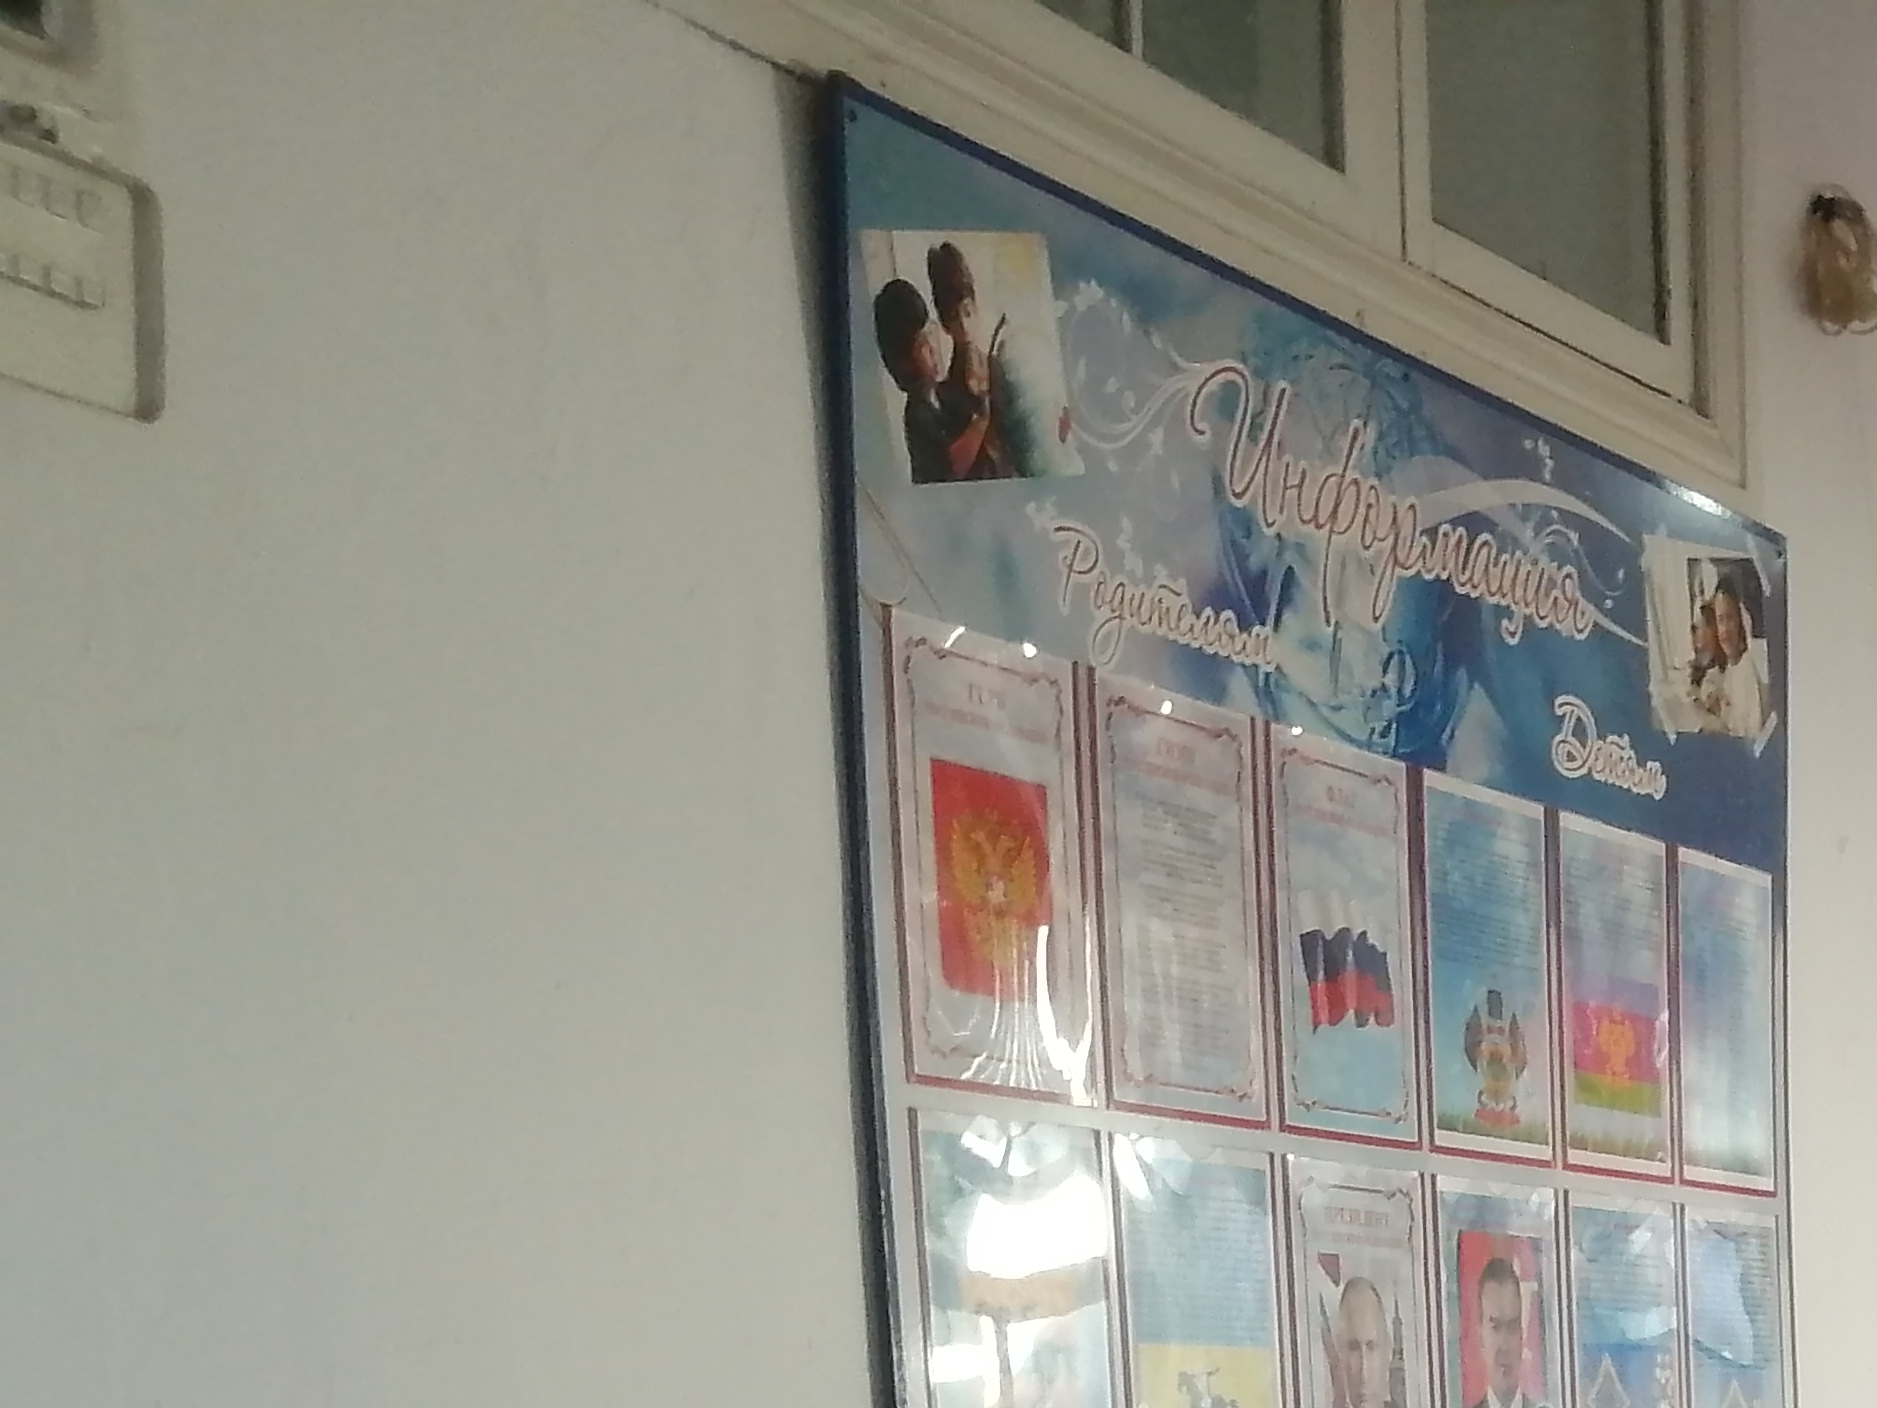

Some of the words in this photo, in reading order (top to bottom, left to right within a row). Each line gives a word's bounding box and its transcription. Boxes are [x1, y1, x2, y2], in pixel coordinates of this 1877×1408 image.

[1189, 365, 1594, 641] Информация
[1052, 524, 1278, 668] Родителям
[1553, 696, 1665, 798] Детям
